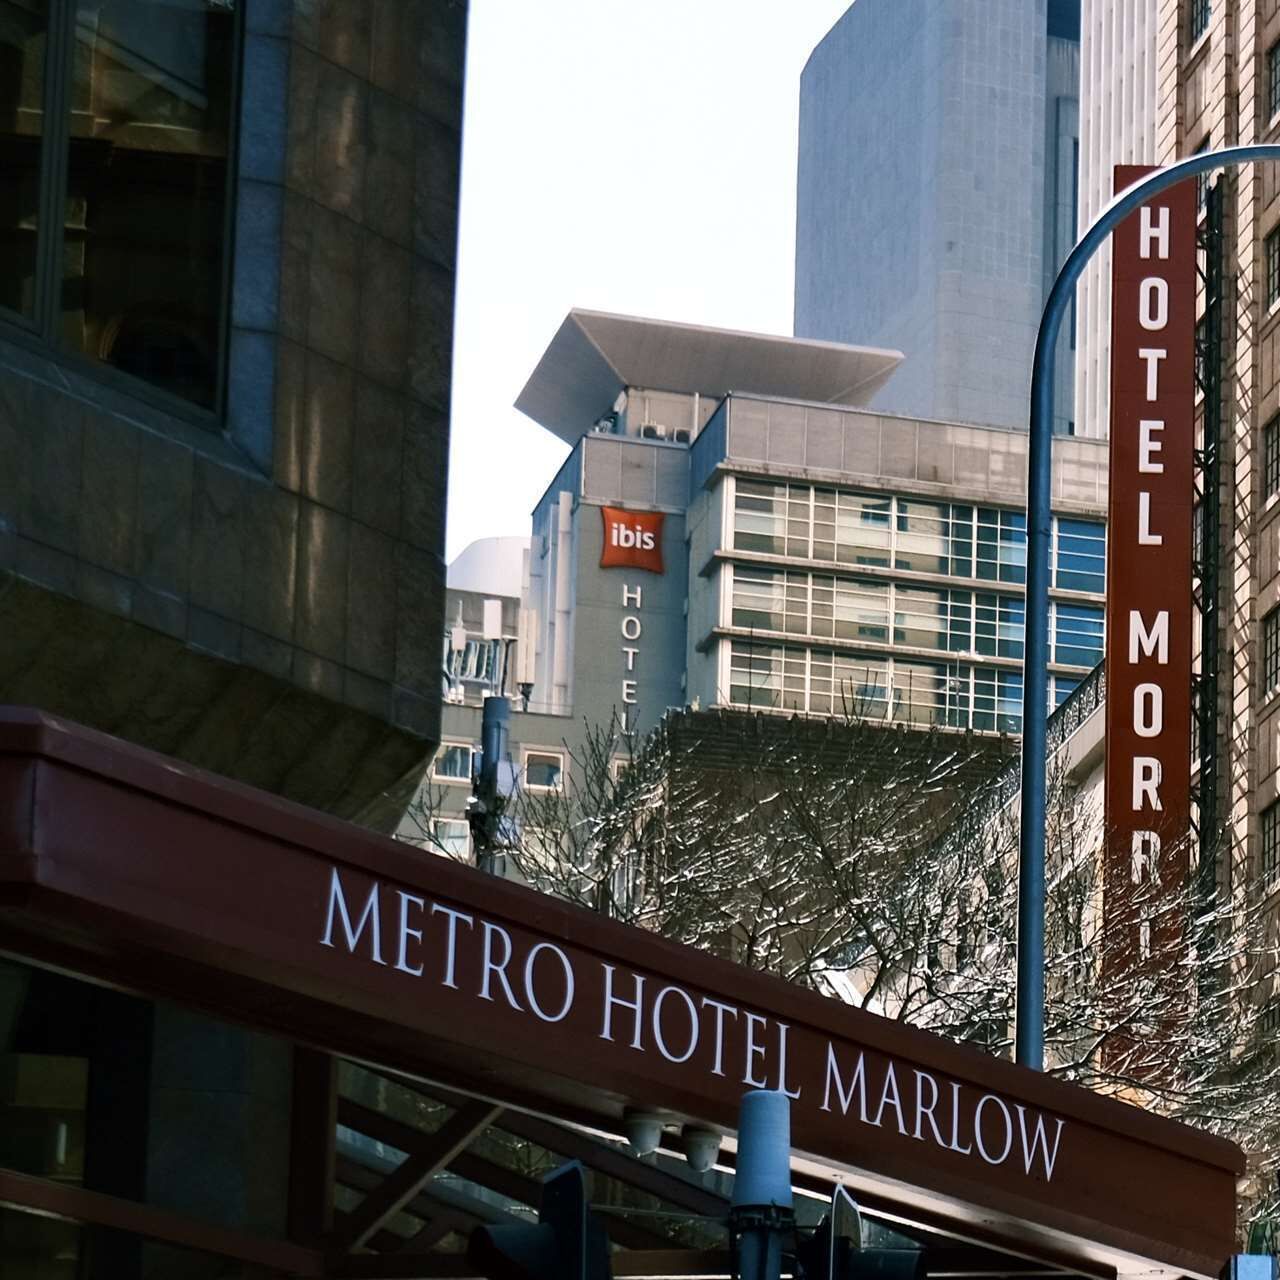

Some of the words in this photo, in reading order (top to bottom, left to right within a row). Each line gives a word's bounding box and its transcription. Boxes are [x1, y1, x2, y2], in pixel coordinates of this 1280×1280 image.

[1138, 206, 1170, 546] HOTEL
[611, 523, 655, 550] ibis
[621, 583, 641, 737] HOTEL
[319, 866, 575, 1023] METRO
[600, 962, 802, 1100] HOTEL
[820, 1040, 1066, 1183] MARLOW
